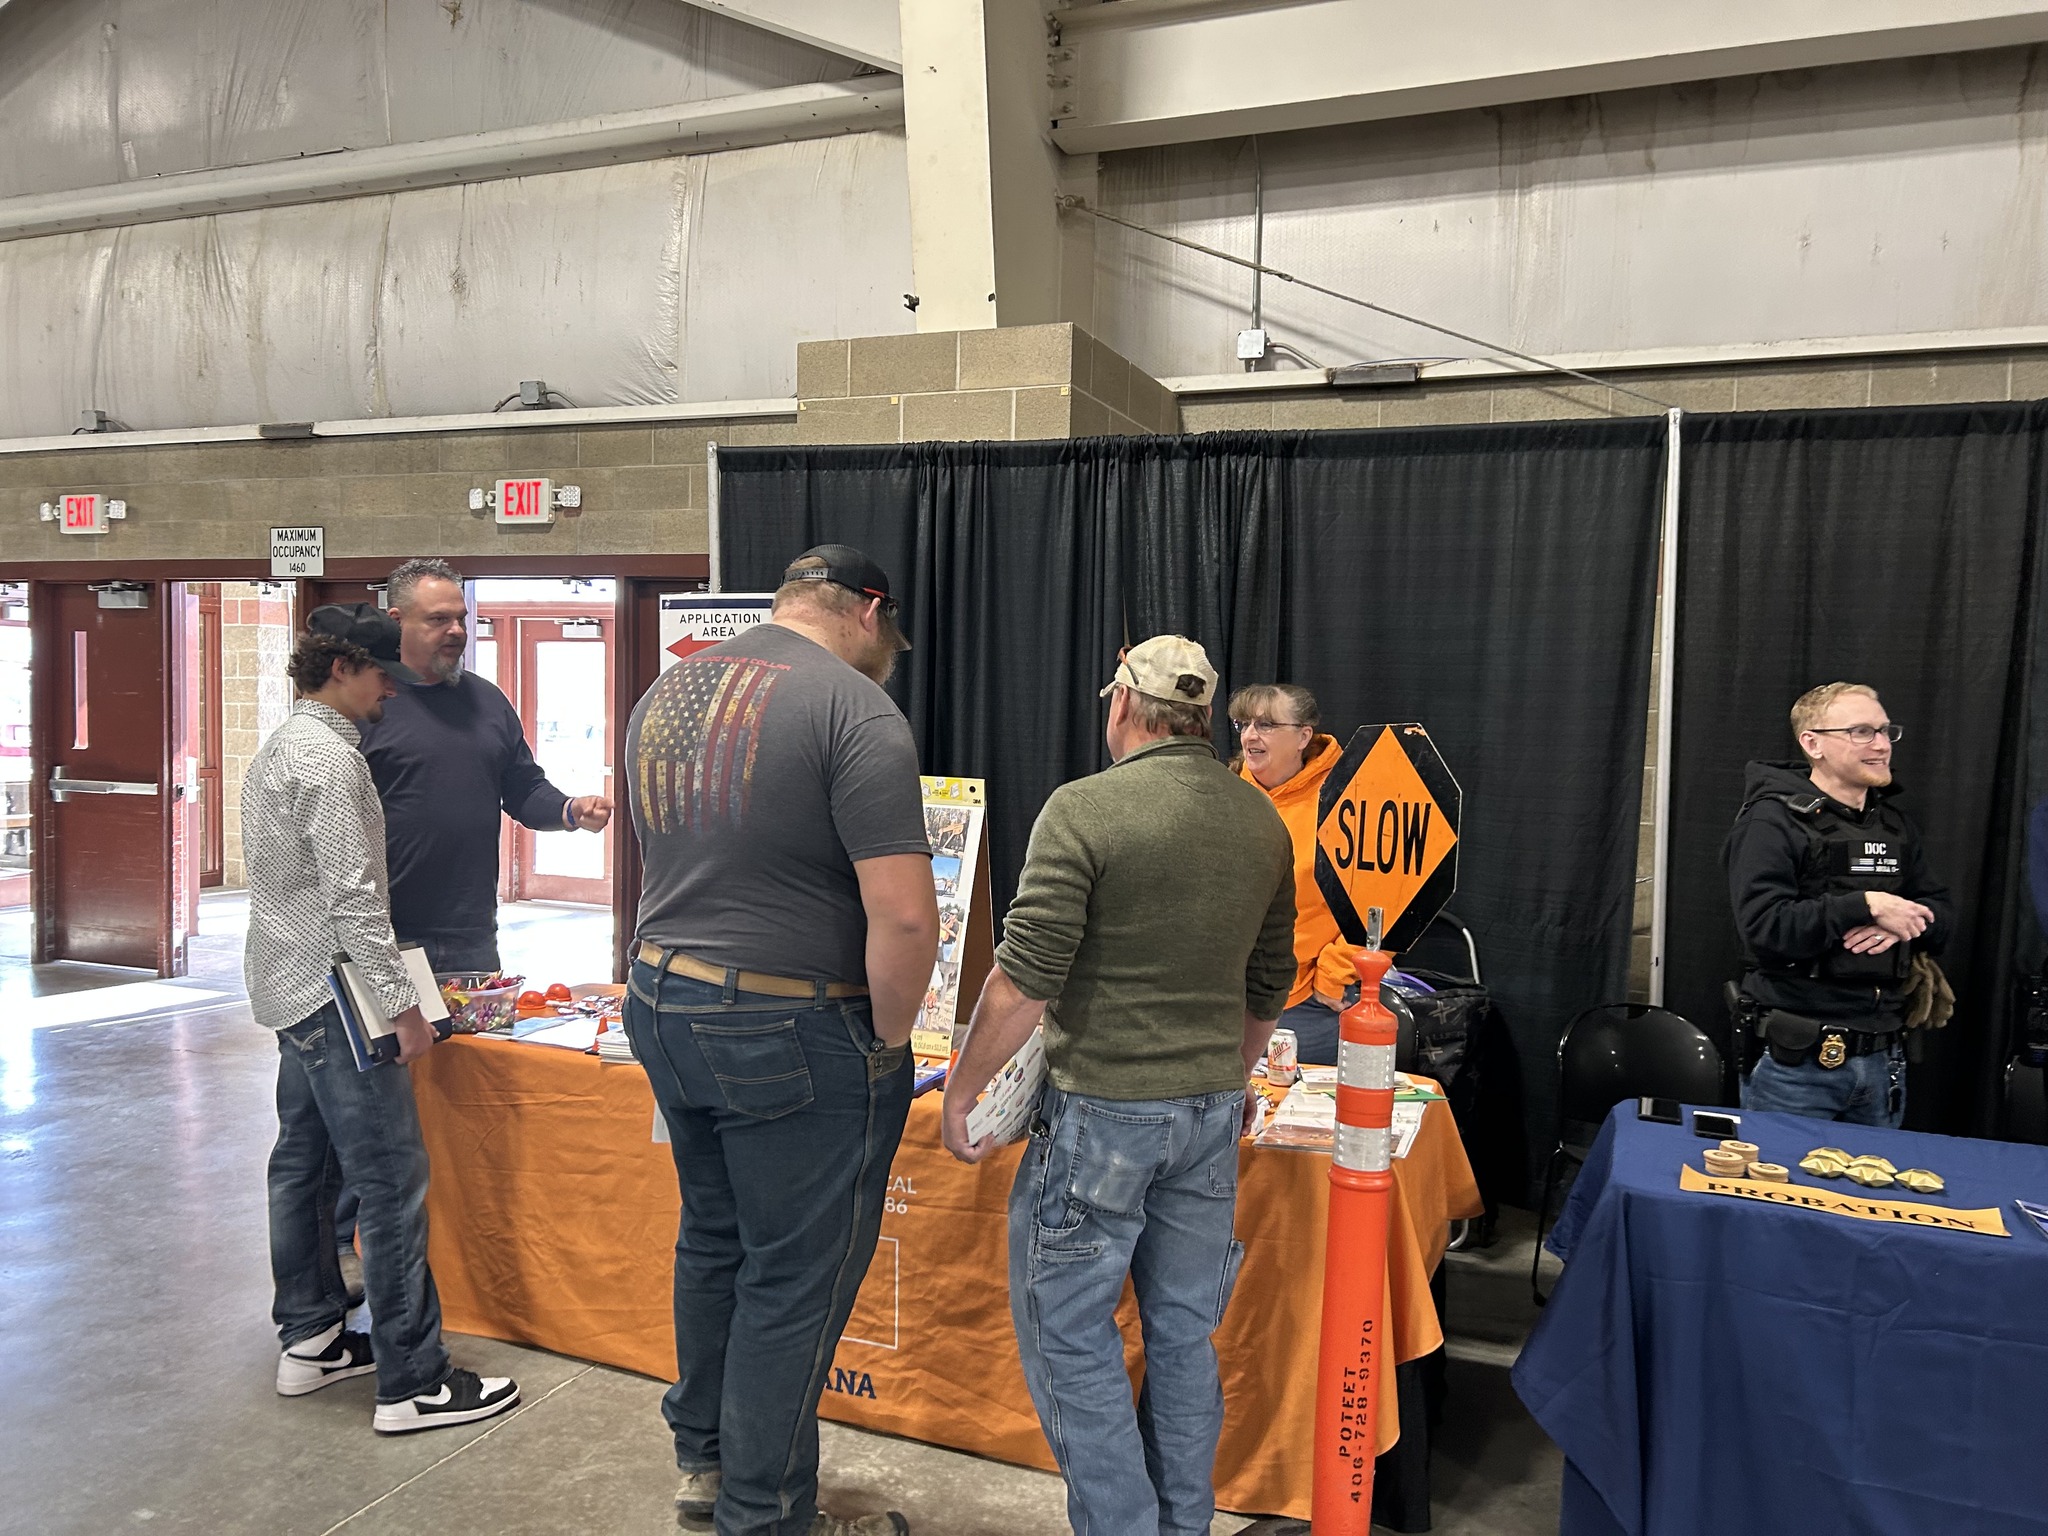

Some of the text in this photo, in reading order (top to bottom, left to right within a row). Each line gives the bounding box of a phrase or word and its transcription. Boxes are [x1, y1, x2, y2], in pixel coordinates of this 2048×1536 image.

[504, 481, 541, 516] EXIT
[66, 496, 95, 527] EXIT
[277, 529, 317, 541] MAXIMUM
[272, 545, 321, 558] OCCUPANCY
[289, 562, 306, 573] 1460
[679, 612, 762, 625] APPLICATION
[702, 626, 736, 637] AREA
[748, 658, 792, 671] COLLAR
[1335, 798, 1432, 877] SLOW
[1864, 842, 1887, 855] DOC
[1707, 1181, 1976, 1230] PROBATION
[1338, 1366, 1357, 1458] POTEET
[1350, 1319, 1373, 1503] 406-728-9370
